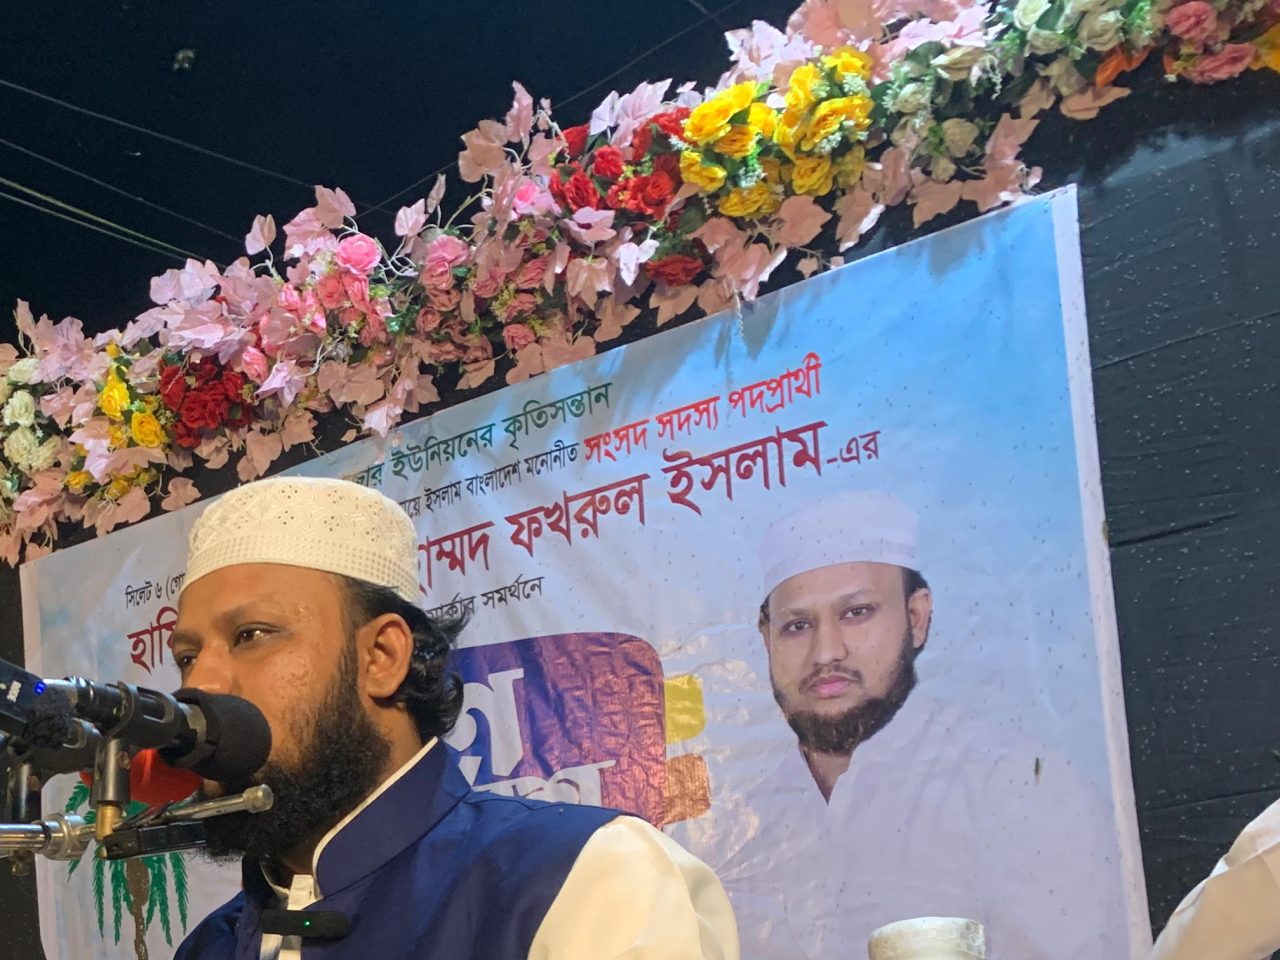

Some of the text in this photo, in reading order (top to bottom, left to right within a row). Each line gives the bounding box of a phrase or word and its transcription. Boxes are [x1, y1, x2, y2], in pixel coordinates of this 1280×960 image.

[391, 422, 496, 480] ইউনিয়নের
[501, 382, 613, 449] কৃতিসন্তান
[125, 580, 153, 609] সিলেট
[155, 583, 162, 599] ৬
[424, 480, 462, 513] ইসলাম
[466, 460, 522, 496] বাংলাদেশ
[524, 439, 579, 475] মনোনীত
[584, 418, 650, 463] সংসদ
[655, 395, 721, 440] সদস্য
[504, 473, 651, 557] ফখরুল
[481, 574, 545, 609] সমর্থনে
